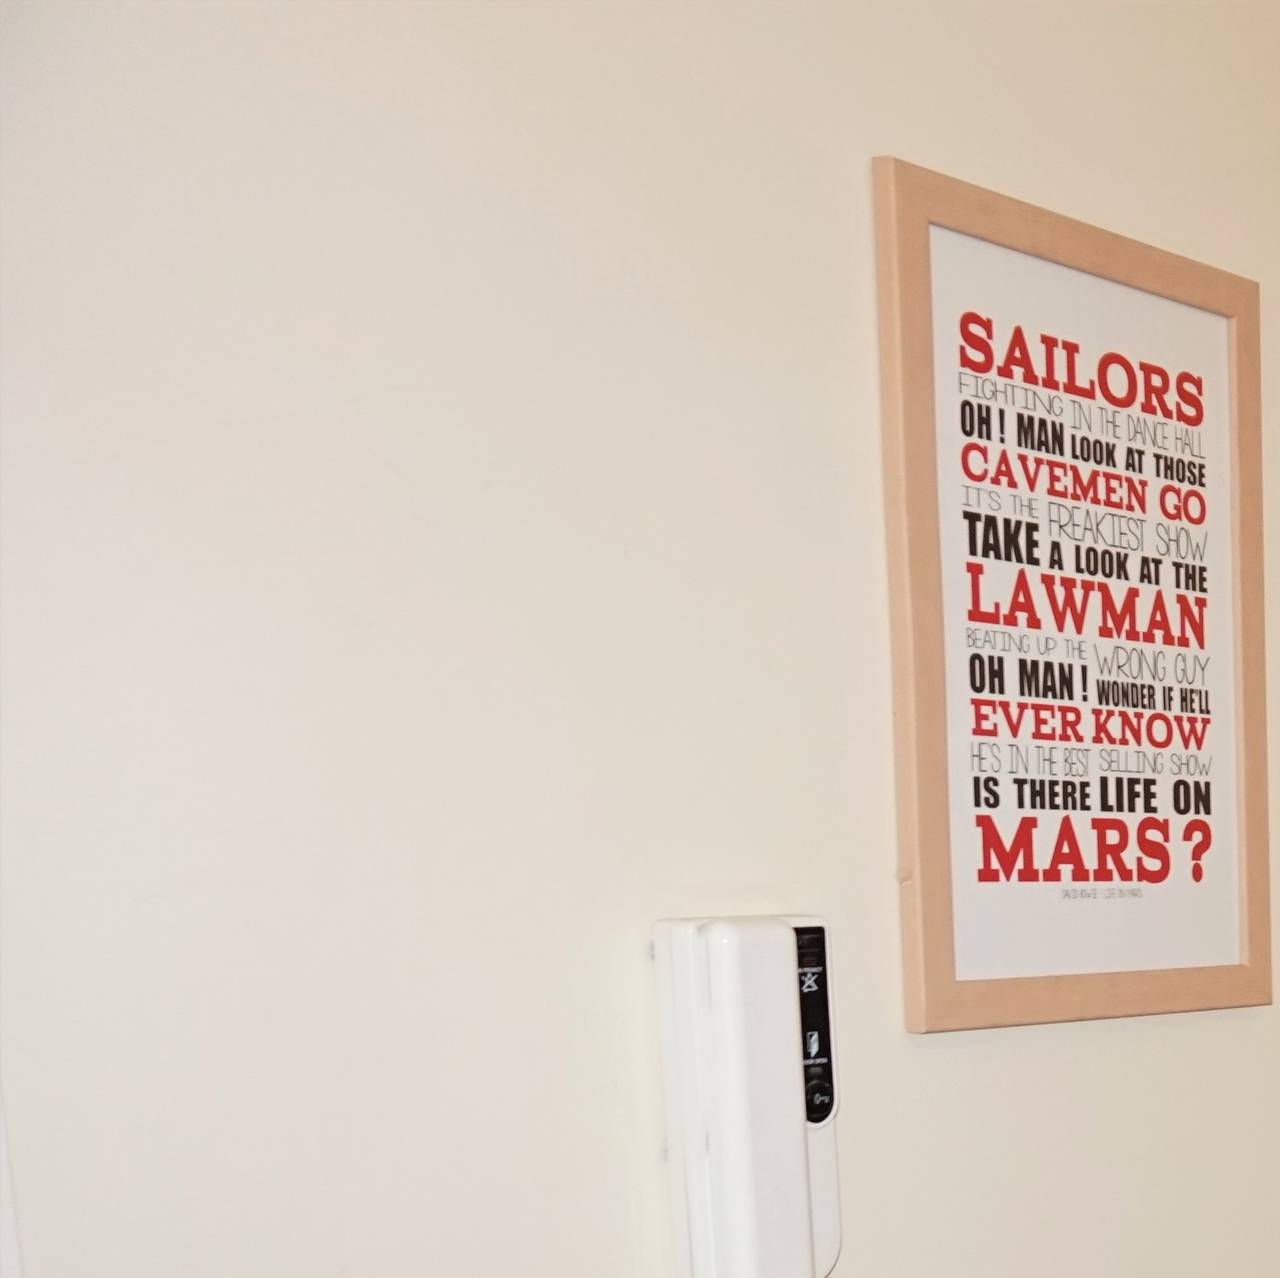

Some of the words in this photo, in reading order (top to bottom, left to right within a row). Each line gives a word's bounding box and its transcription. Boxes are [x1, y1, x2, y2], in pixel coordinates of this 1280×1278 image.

[960, 312, 1203, 426] SAILORS
[958, 372, 1063, 416] FIGHTING
[1070, 400, 1091, 432] IN
[1099, 406, 1120, 439] THE
[1127, 414, 1168, 449] DANCE
[1175, 427, 1206, 458] HALL
[1017, 412, 1064, 456] MAN
[1071, 434, 1116, 467] LOOK
[1126, 447, 1144, 474] AT
[1154, 454, 1206, 487] THOSE
[961, 442, 1147, 514] CAVEMEN
[1160, 484, 1206, 525] GO
[962, 485, 1002, 511] IT'S
[1010, 494, 1038, 518] THE
[1048, 502, 1146, 551] FREAKIEST
[1156, 523, 1207, 561] SHOW
[963, 511, 1040, 566] TAKE
[1050, 541, 1064, 571] A
[1075, 545, 1129, 581] LOOK
[1140, 556, 1162, 585] AT
[1172, 561, 1208, 593] THE
[966, 562, 1207, 649] LAWMAN
[966, 627, 1031, 653] BEATING
[1037, 636, 1057, 655] UP
[1064, 639, 1087, 660] THE
[1094, 643, 1166, 682] WRONG
[1174, 653, 1211, 686] GUY
[969, 653, 1005, 694] OH
[1096, 679, 1155, 710] WONDER
[1163, 686, 1173, 711] IF
[1180, 688, 1211, 714] HE'LL
[970, 698, 1084, 742] EVER
[1091, 708, 1211, 751] KNOW
[971, 742, 1002, 773] HE'S
[1008, 744, 1028, 775] IN
[1036, 745, 1057, 776] THE
[1064, 748, 1090, 777] BEST
[1100, 750, 1164, 775] SELLING
[1170, 753, 1212, 776] SHOW
[973, 776, 1000, 808] IS
[1013, 778, 1091, 810] THERE
[1100, 776, 1158, 813] LIFE
[1173, 780, 1211, 815] ON
[976, 815, 1212, 883] MARS?
